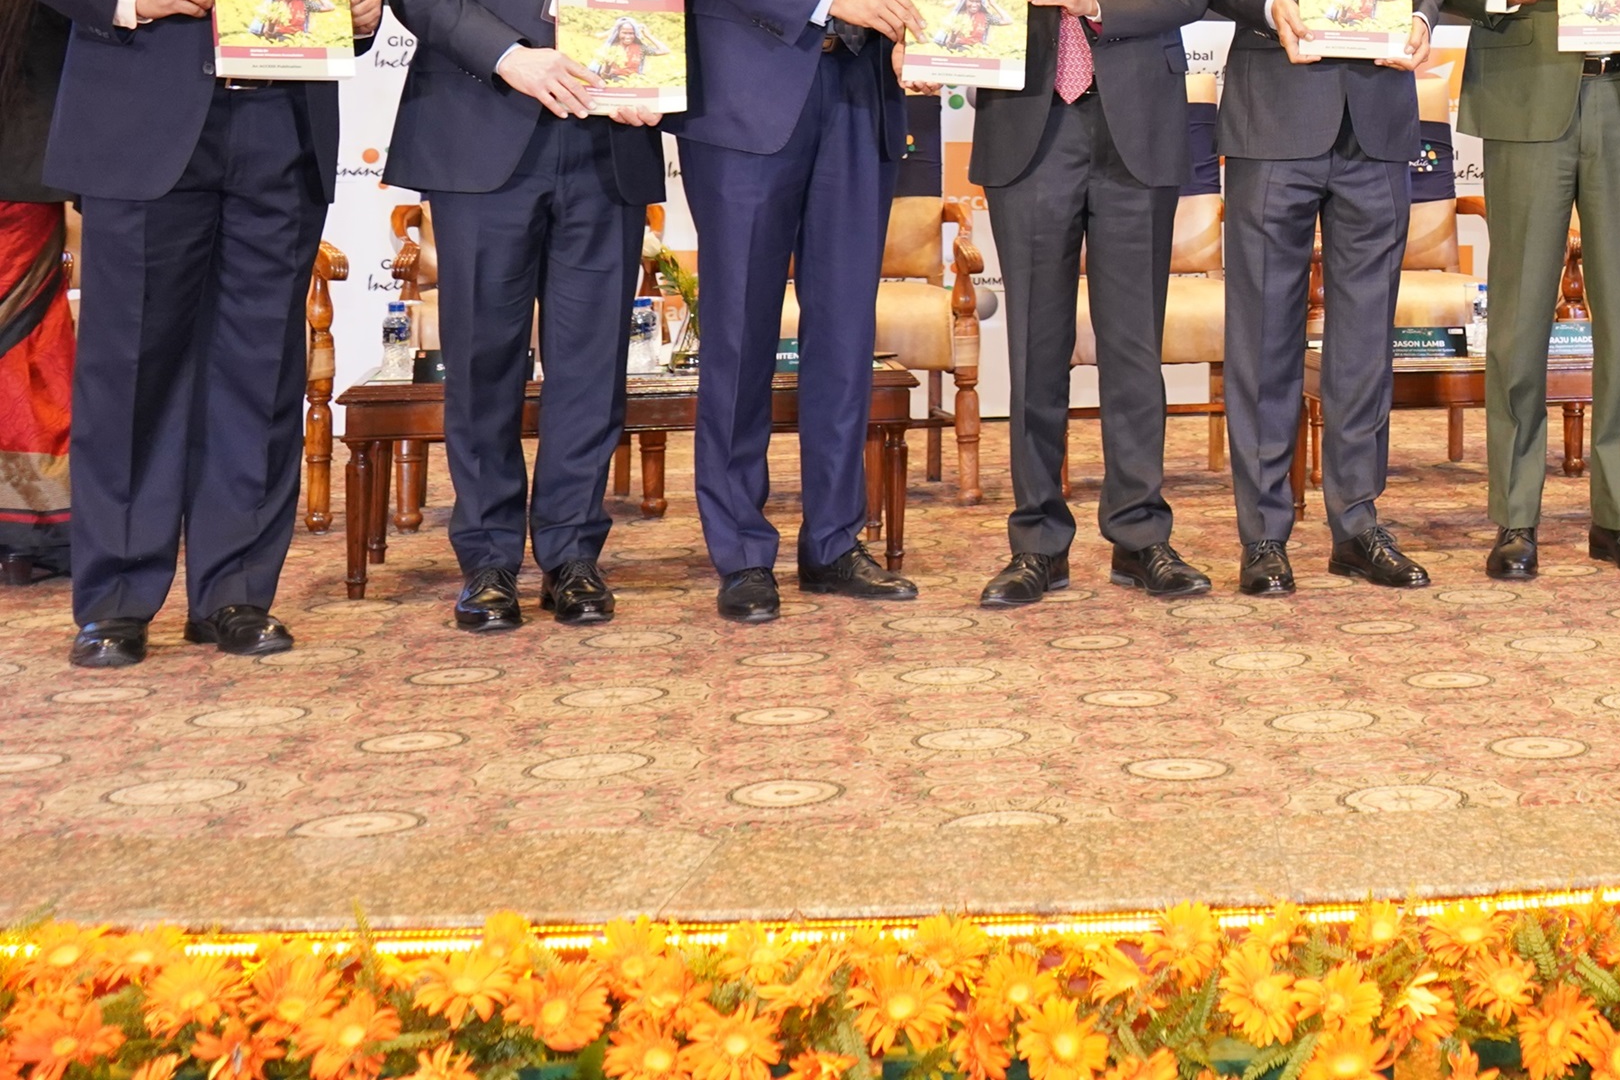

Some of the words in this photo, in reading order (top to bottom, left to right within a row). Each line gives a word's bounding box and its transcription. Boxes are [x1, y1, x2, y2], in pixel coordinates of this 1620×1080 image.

[387, 35, 416, 47] Glo
[1185, 50, 1214, 61] obal
[1393, 340, 1420, 348] JASON
[1421, 340, 1446, 348] LAMB
[1549, 336, 1569, 344] RAJU
